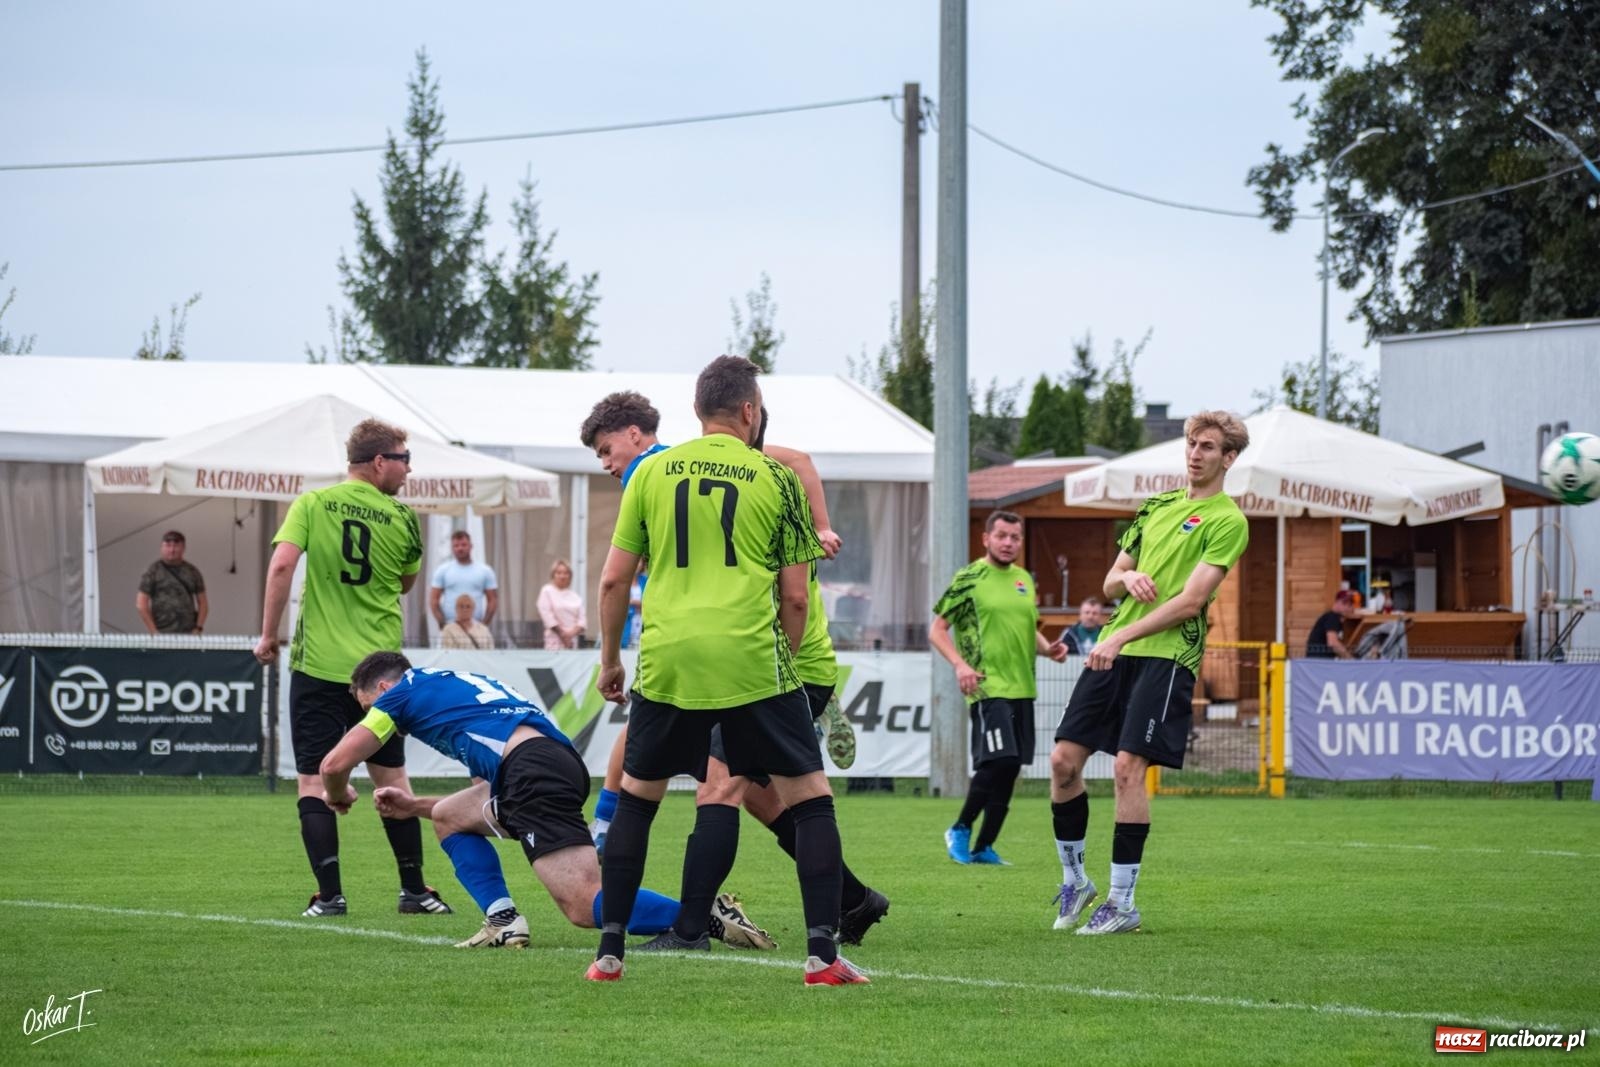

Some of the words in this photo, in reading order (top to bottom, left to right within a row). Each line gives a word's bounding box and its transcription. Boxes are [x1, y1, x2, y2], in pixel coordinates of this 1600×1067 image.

[195, 468, 305, 496] RACIBORSKIE
[665, 461, 685, 476] LKS
[690, 461, 757, 483] CYPRZANÓW
[1279, 478, 1374, 514] RACIBORSKIE
[341, 503, 392, 526] CYPRZANÓW
[674, 478, 739, 568] 17
[340, 519, 373, 586] 9
[116, 680, 254, 713] SPORT
[1316, 680, 1526, 718] AKADEMIA
[176, 716, 212, 724] MACRON
[986, 728, 1004, 753] 11
[1318, 721, 1399, 756] UNII
[1415, 715, 1600, 759] RACIBÓR
